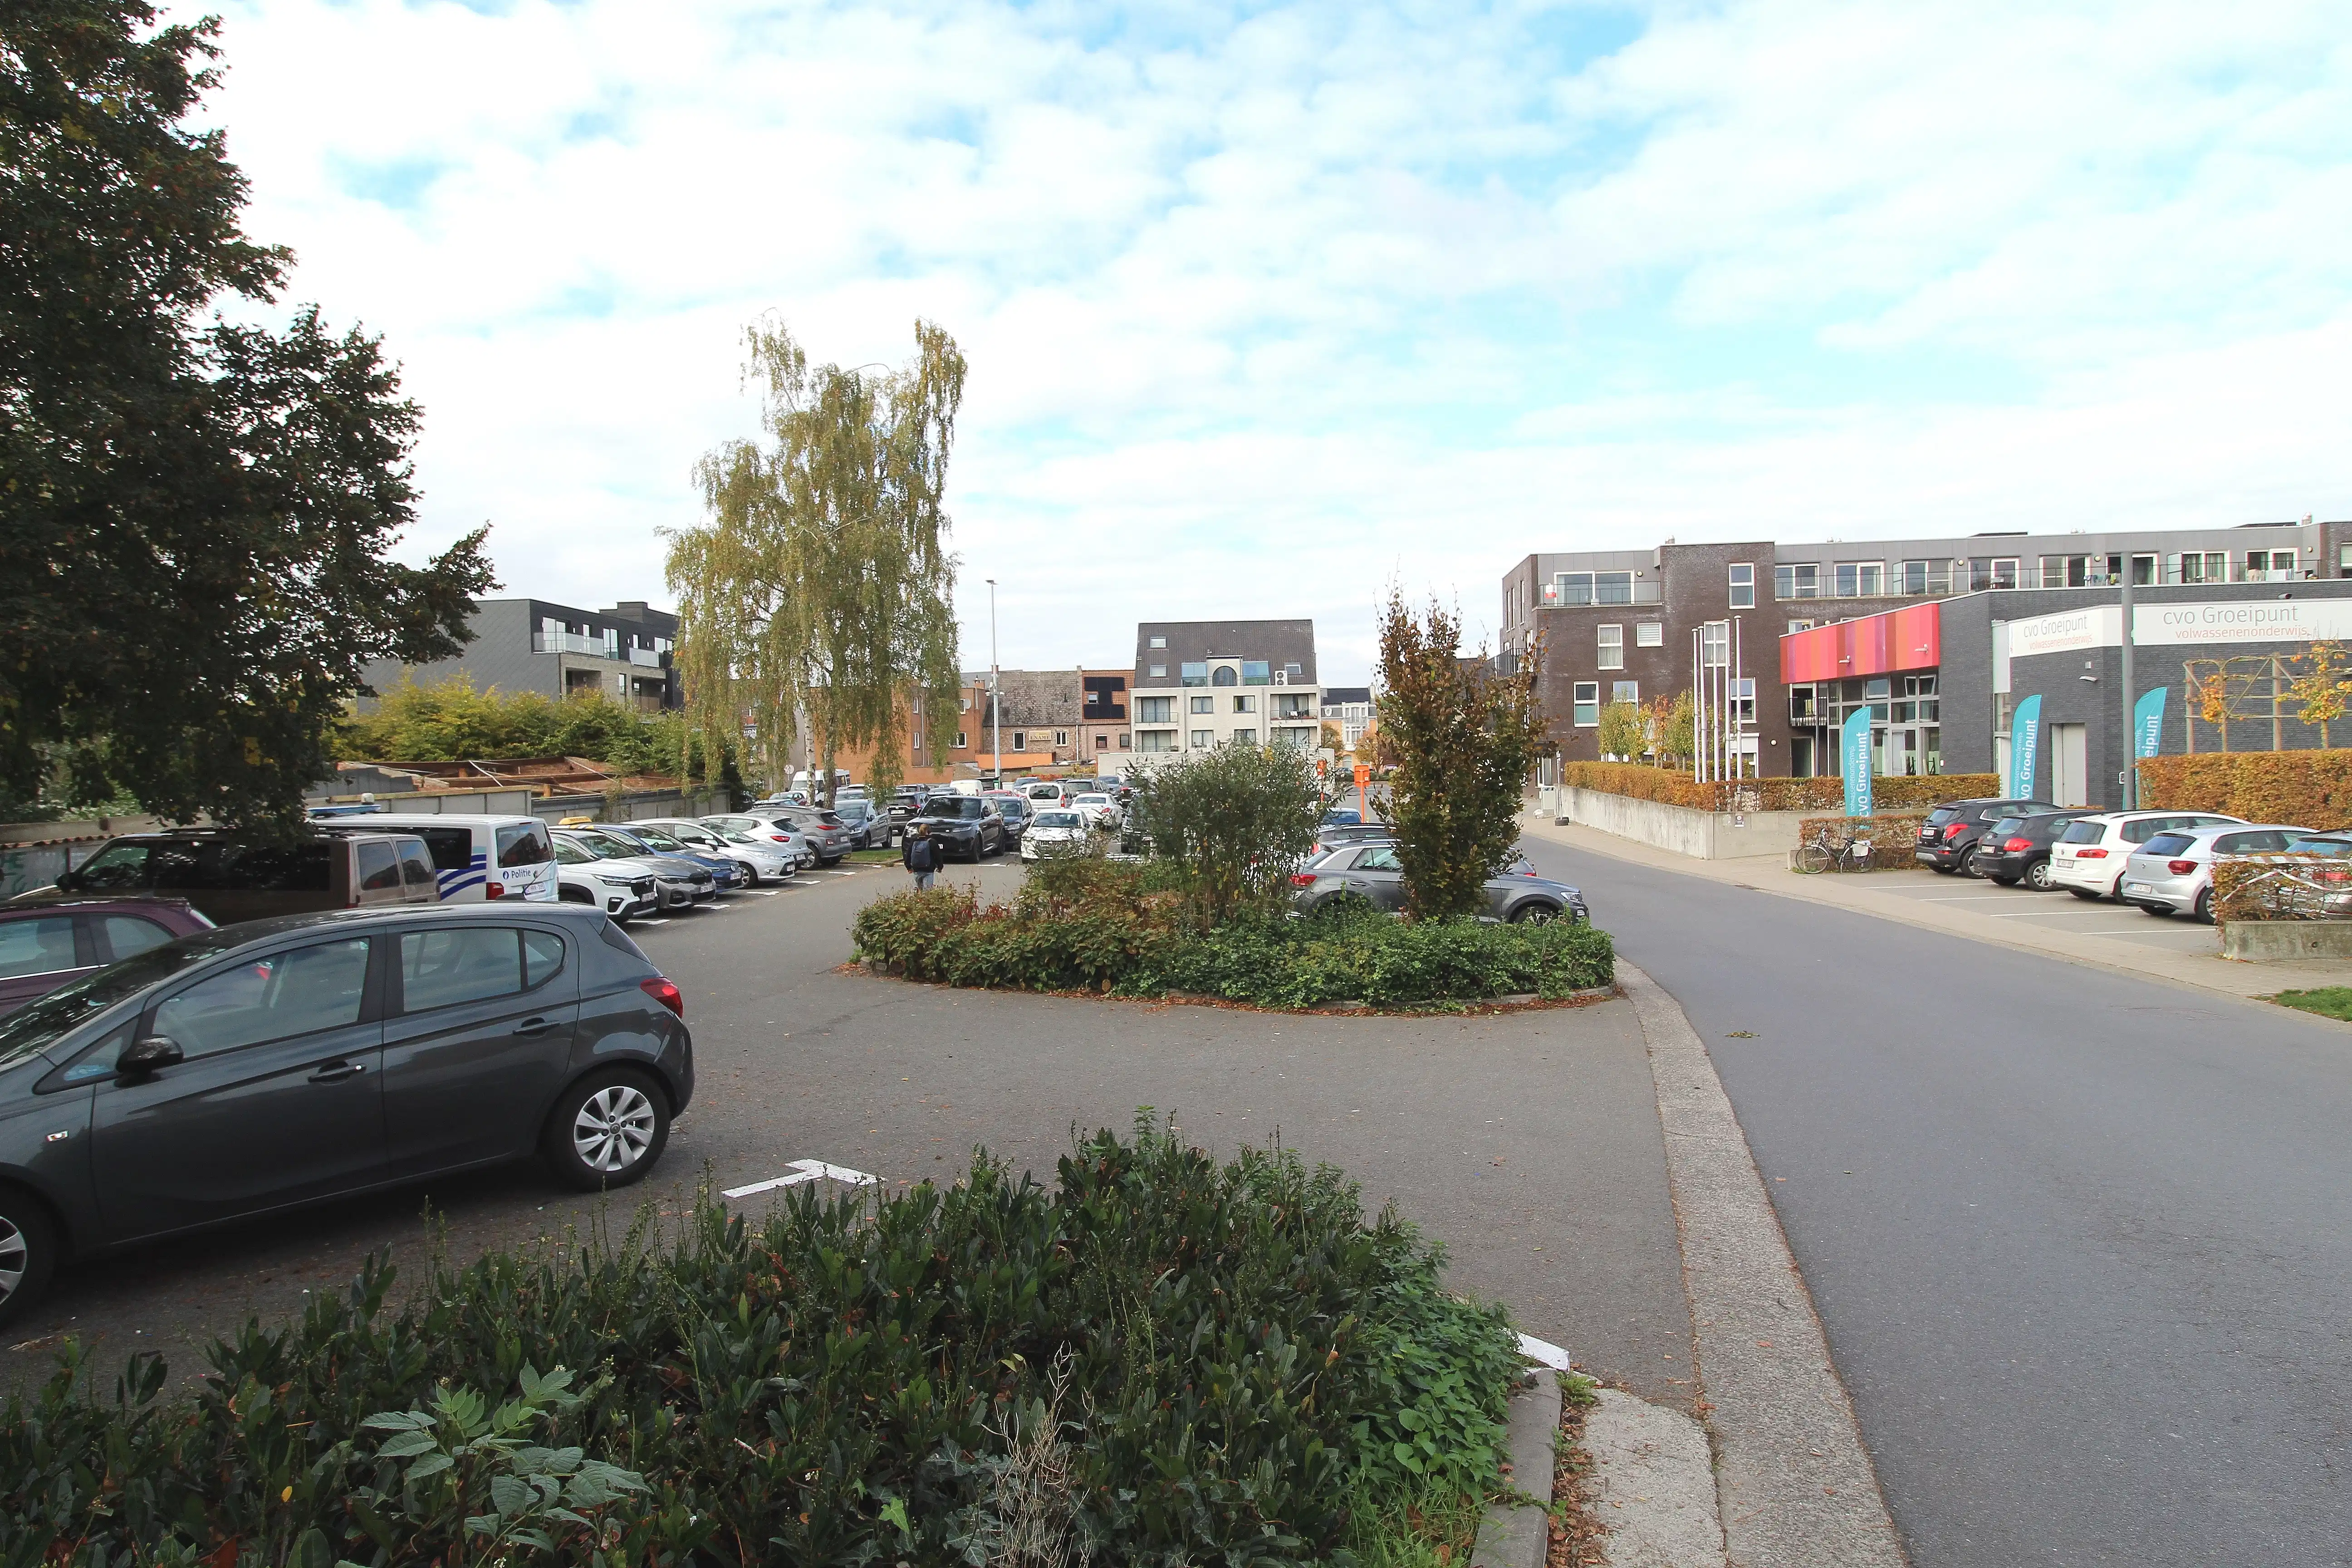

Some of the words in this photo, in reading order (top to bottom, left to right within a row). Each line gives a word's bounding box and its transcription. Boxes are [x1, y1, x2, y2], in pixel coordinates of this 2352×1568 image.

[2024, 625, 2038, 637] cvo
[2041, 615, 2087, 636] Groeipunt
[2163, 611, 2195, 625] cvo
[2202, 606, 2299, 627] Groeipunt
[2029, 633, 2092, 650] volwassenenonderwijs
[2175, 625, 2308, 639] volwassenenonderwijs
[2144, 715, 2158, 757] eipunt
[2020, 719, 2036, 780] Groeipunt
[1856, 732, 1867, 792] Groeipunt
[2020, 784, 2031, 800] vo
[1858, 796, 1869, 817] cvo
[511, 869, 531, 878] Politie
